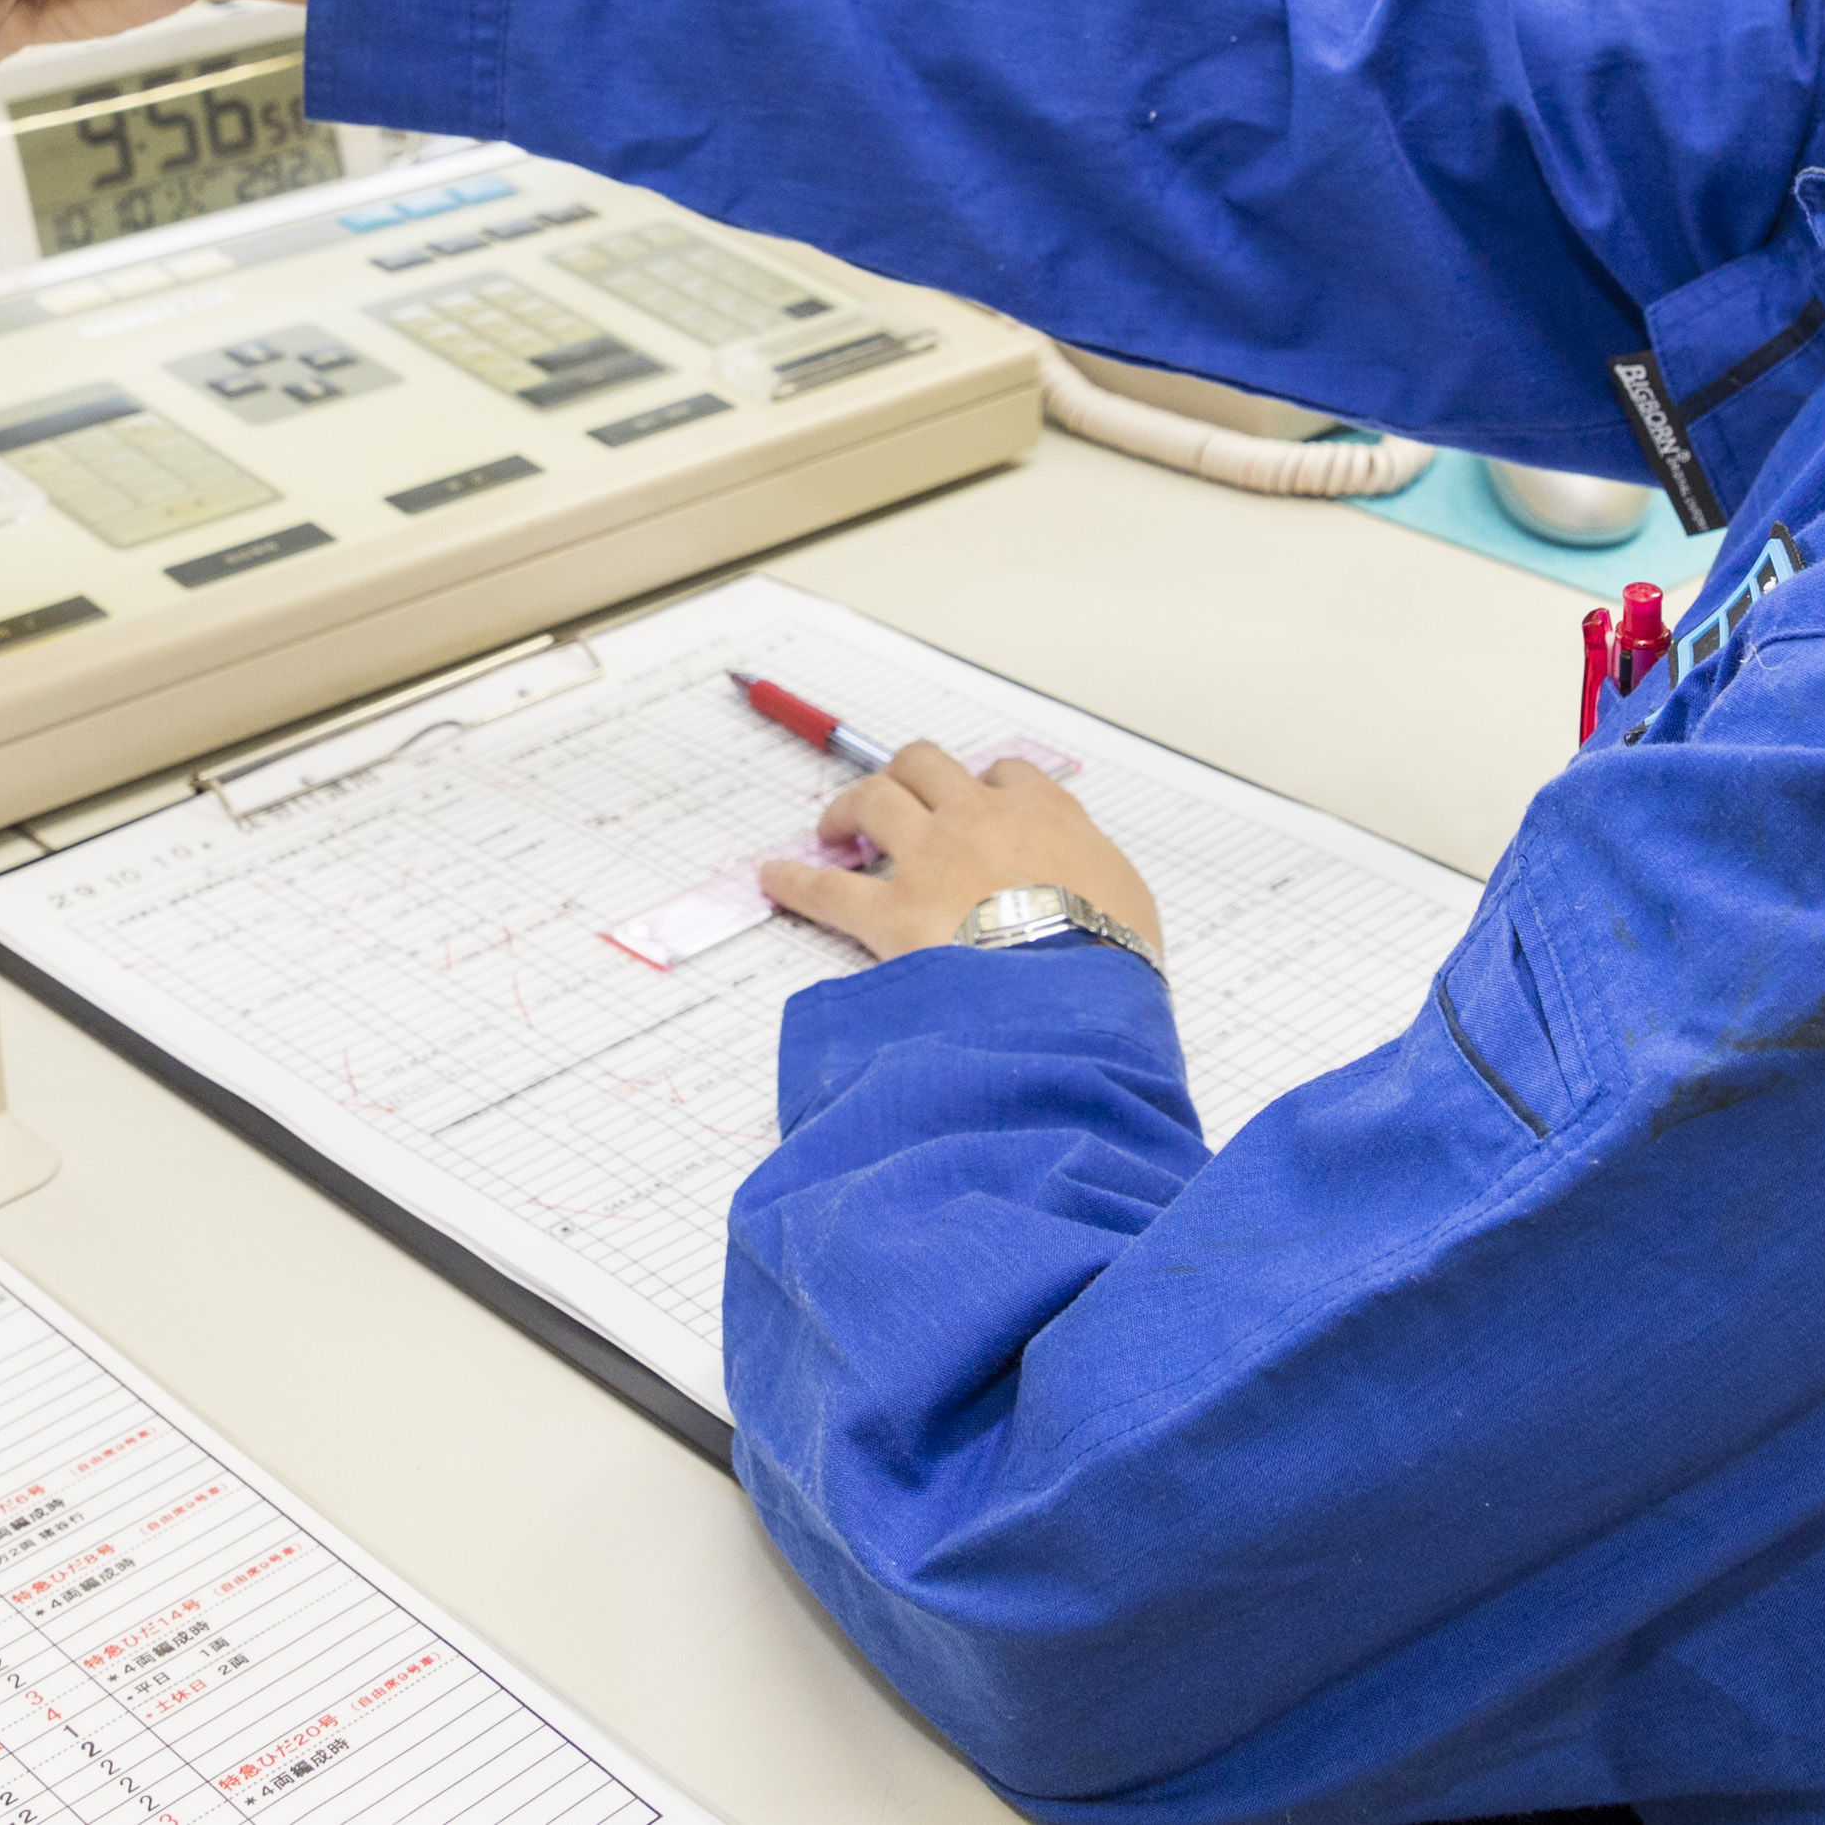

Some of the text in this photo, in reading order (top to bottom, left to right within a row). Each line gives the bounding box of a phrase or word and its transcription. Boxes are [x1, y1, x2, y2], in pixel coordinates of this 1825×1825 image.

[1614, 364, 1681, 458] BIGBORN
[12, 1543, 116, 1605] 特急ひだ8号
[83, 1598, 202, 1671] 特急ひだ14号
[7, 1673, 27, 1690] 2
[25, 1689, 44, 1706] 3
[46, 1707, 62, 1721] 4
[63, 1724, 80, 1738] 1
[80, 1740, 103, 1759] 2
[218, 1713, 340, 1793] 特急ひだ20号
[100, 1758, 122, 1776] 2
[119, 1776, 141, 1794] 2
[139, 1794, 161, 1812] 2
